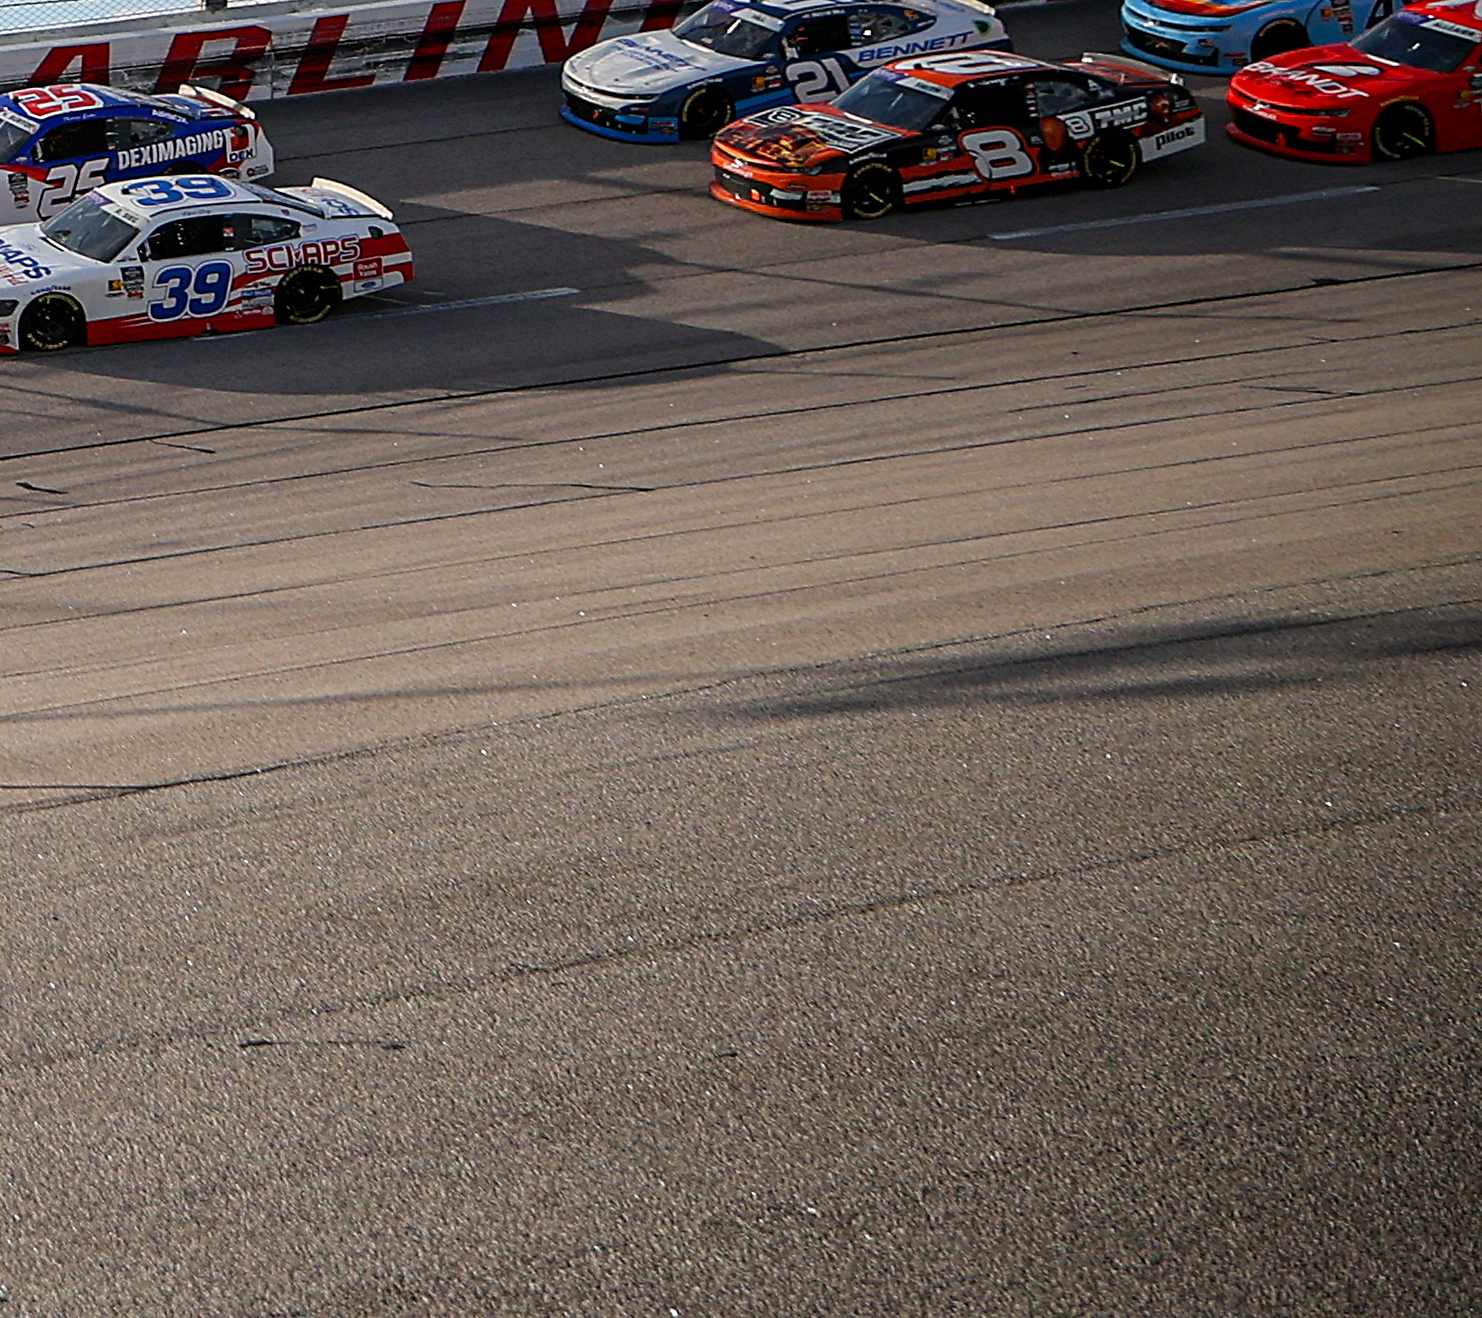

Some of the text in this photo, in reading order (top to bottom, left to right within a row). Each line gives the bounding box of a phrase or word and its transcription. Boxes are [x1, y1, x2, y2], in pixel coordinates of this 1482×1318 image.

[858, 30, 974, 63] BENNETT
[9, 83, 102, 118] 25
[786, 57, 851, 104] 21
[1243, 61, 1370, 99] BRANDT
[117, 127, 224, 171] DEXIMAGING
[229, 149, 255, 162] DEX
[960, 129, 1034, 180] 8
[37, 157, 110, 218] 25
[126, 175, 237, 208] 39
[148, 259, 235, 323] 39
